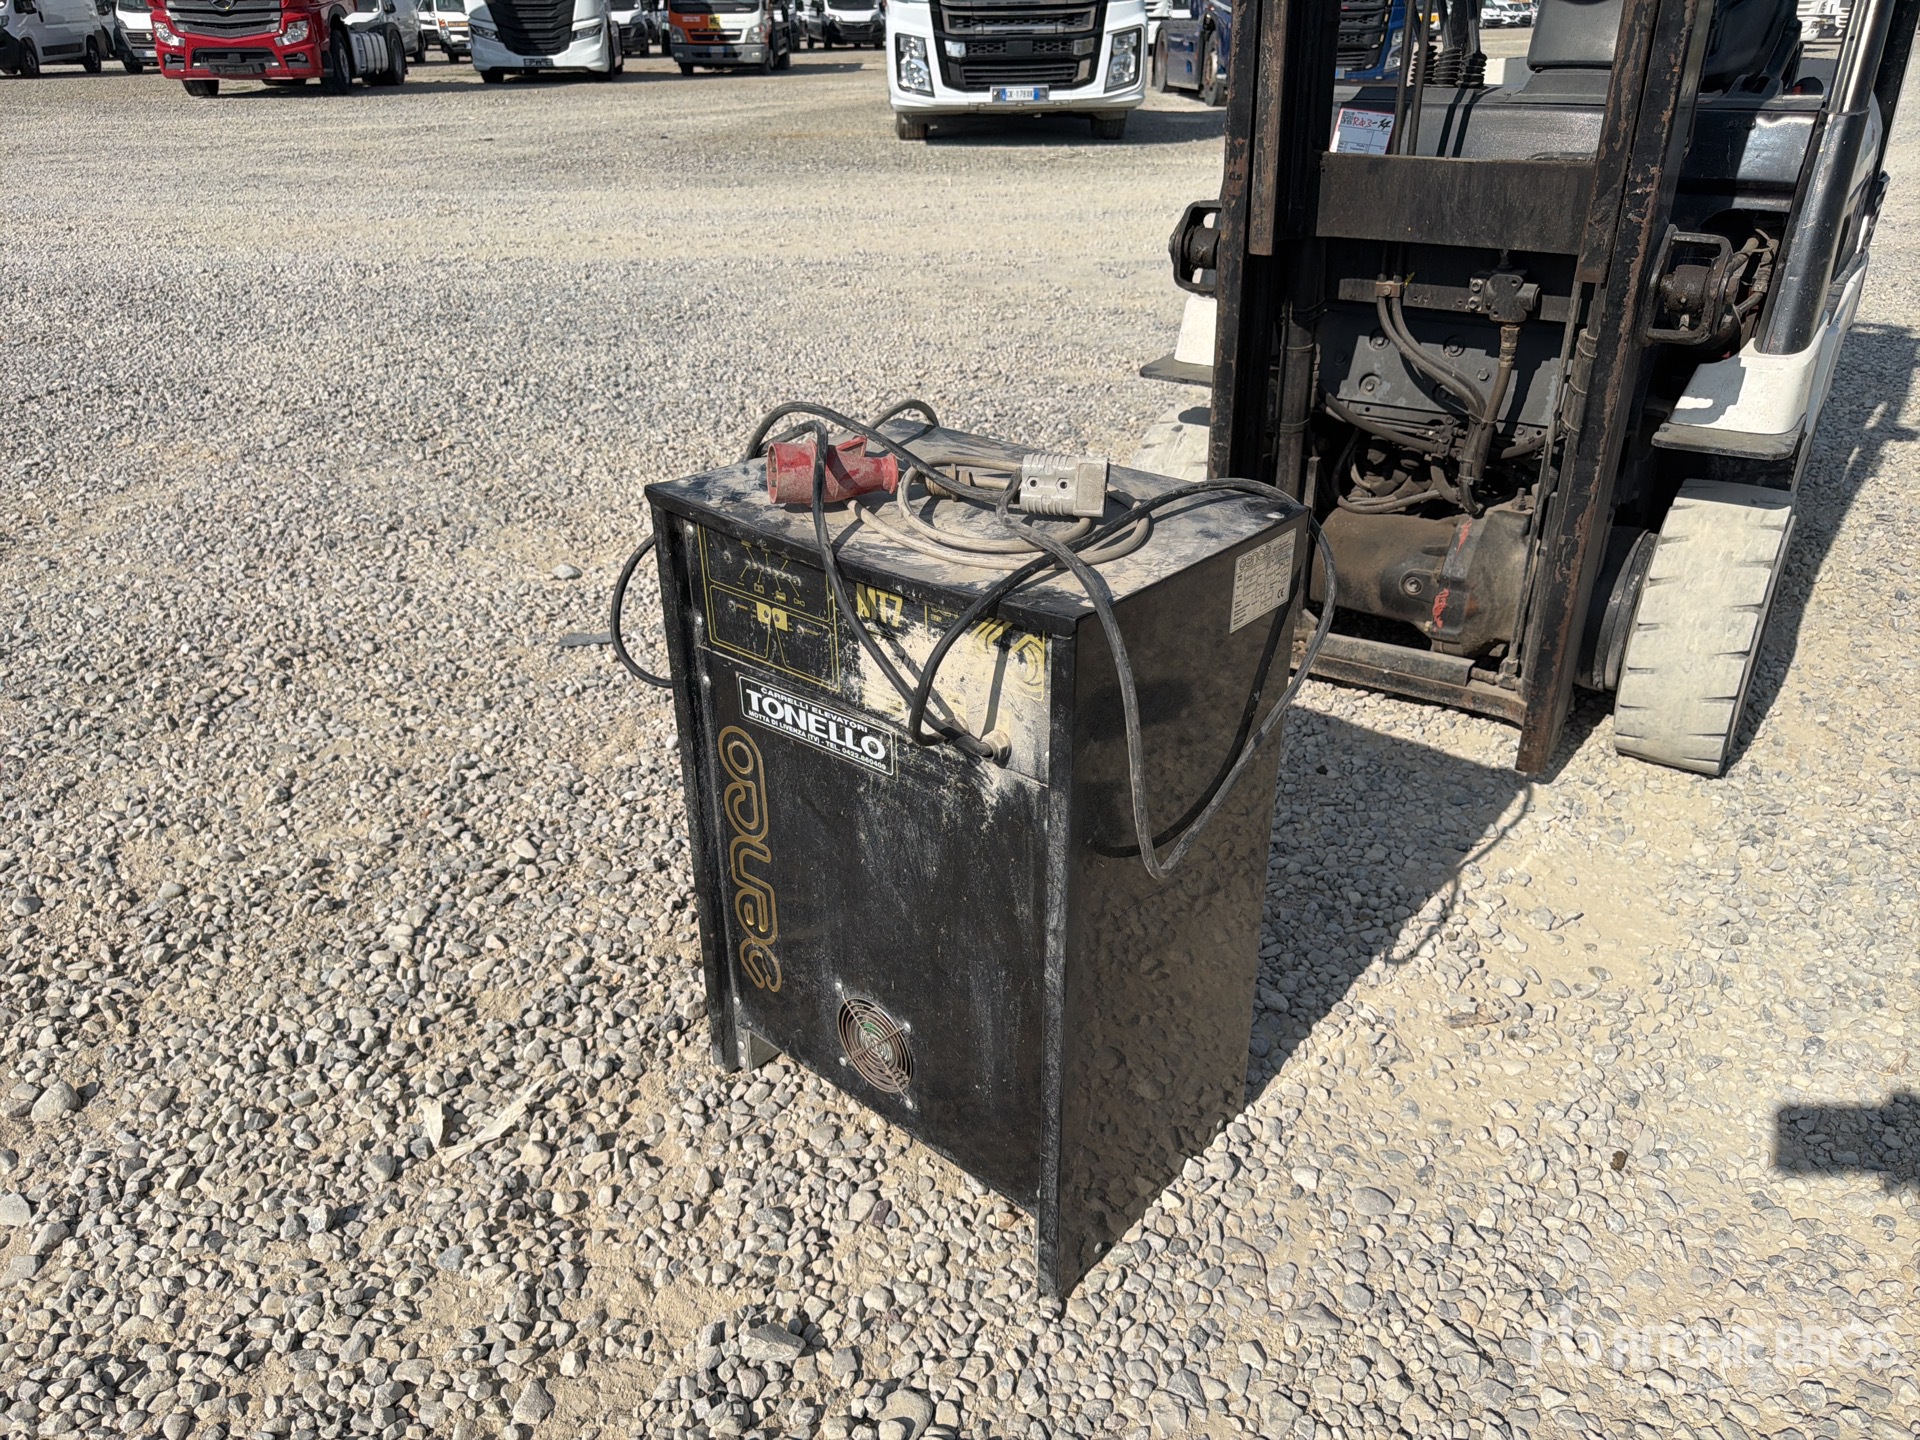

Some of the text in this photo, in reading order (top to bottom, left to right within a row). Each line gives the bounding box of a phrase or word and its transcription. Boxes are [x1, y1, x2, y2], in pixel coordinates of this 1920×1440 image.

[745, 688, 886, 760] TONELLO
[748, 709, 771, 724] MOTTA
[771, 718, 779, 727] DI
[779, 720, 807, 738] LIVENZA
[807, 733, 820, 745] (TV)
[826, 739, 841, 752] TEL.
[760, 687, 868, 733] CARRELLI ELEVATORI
